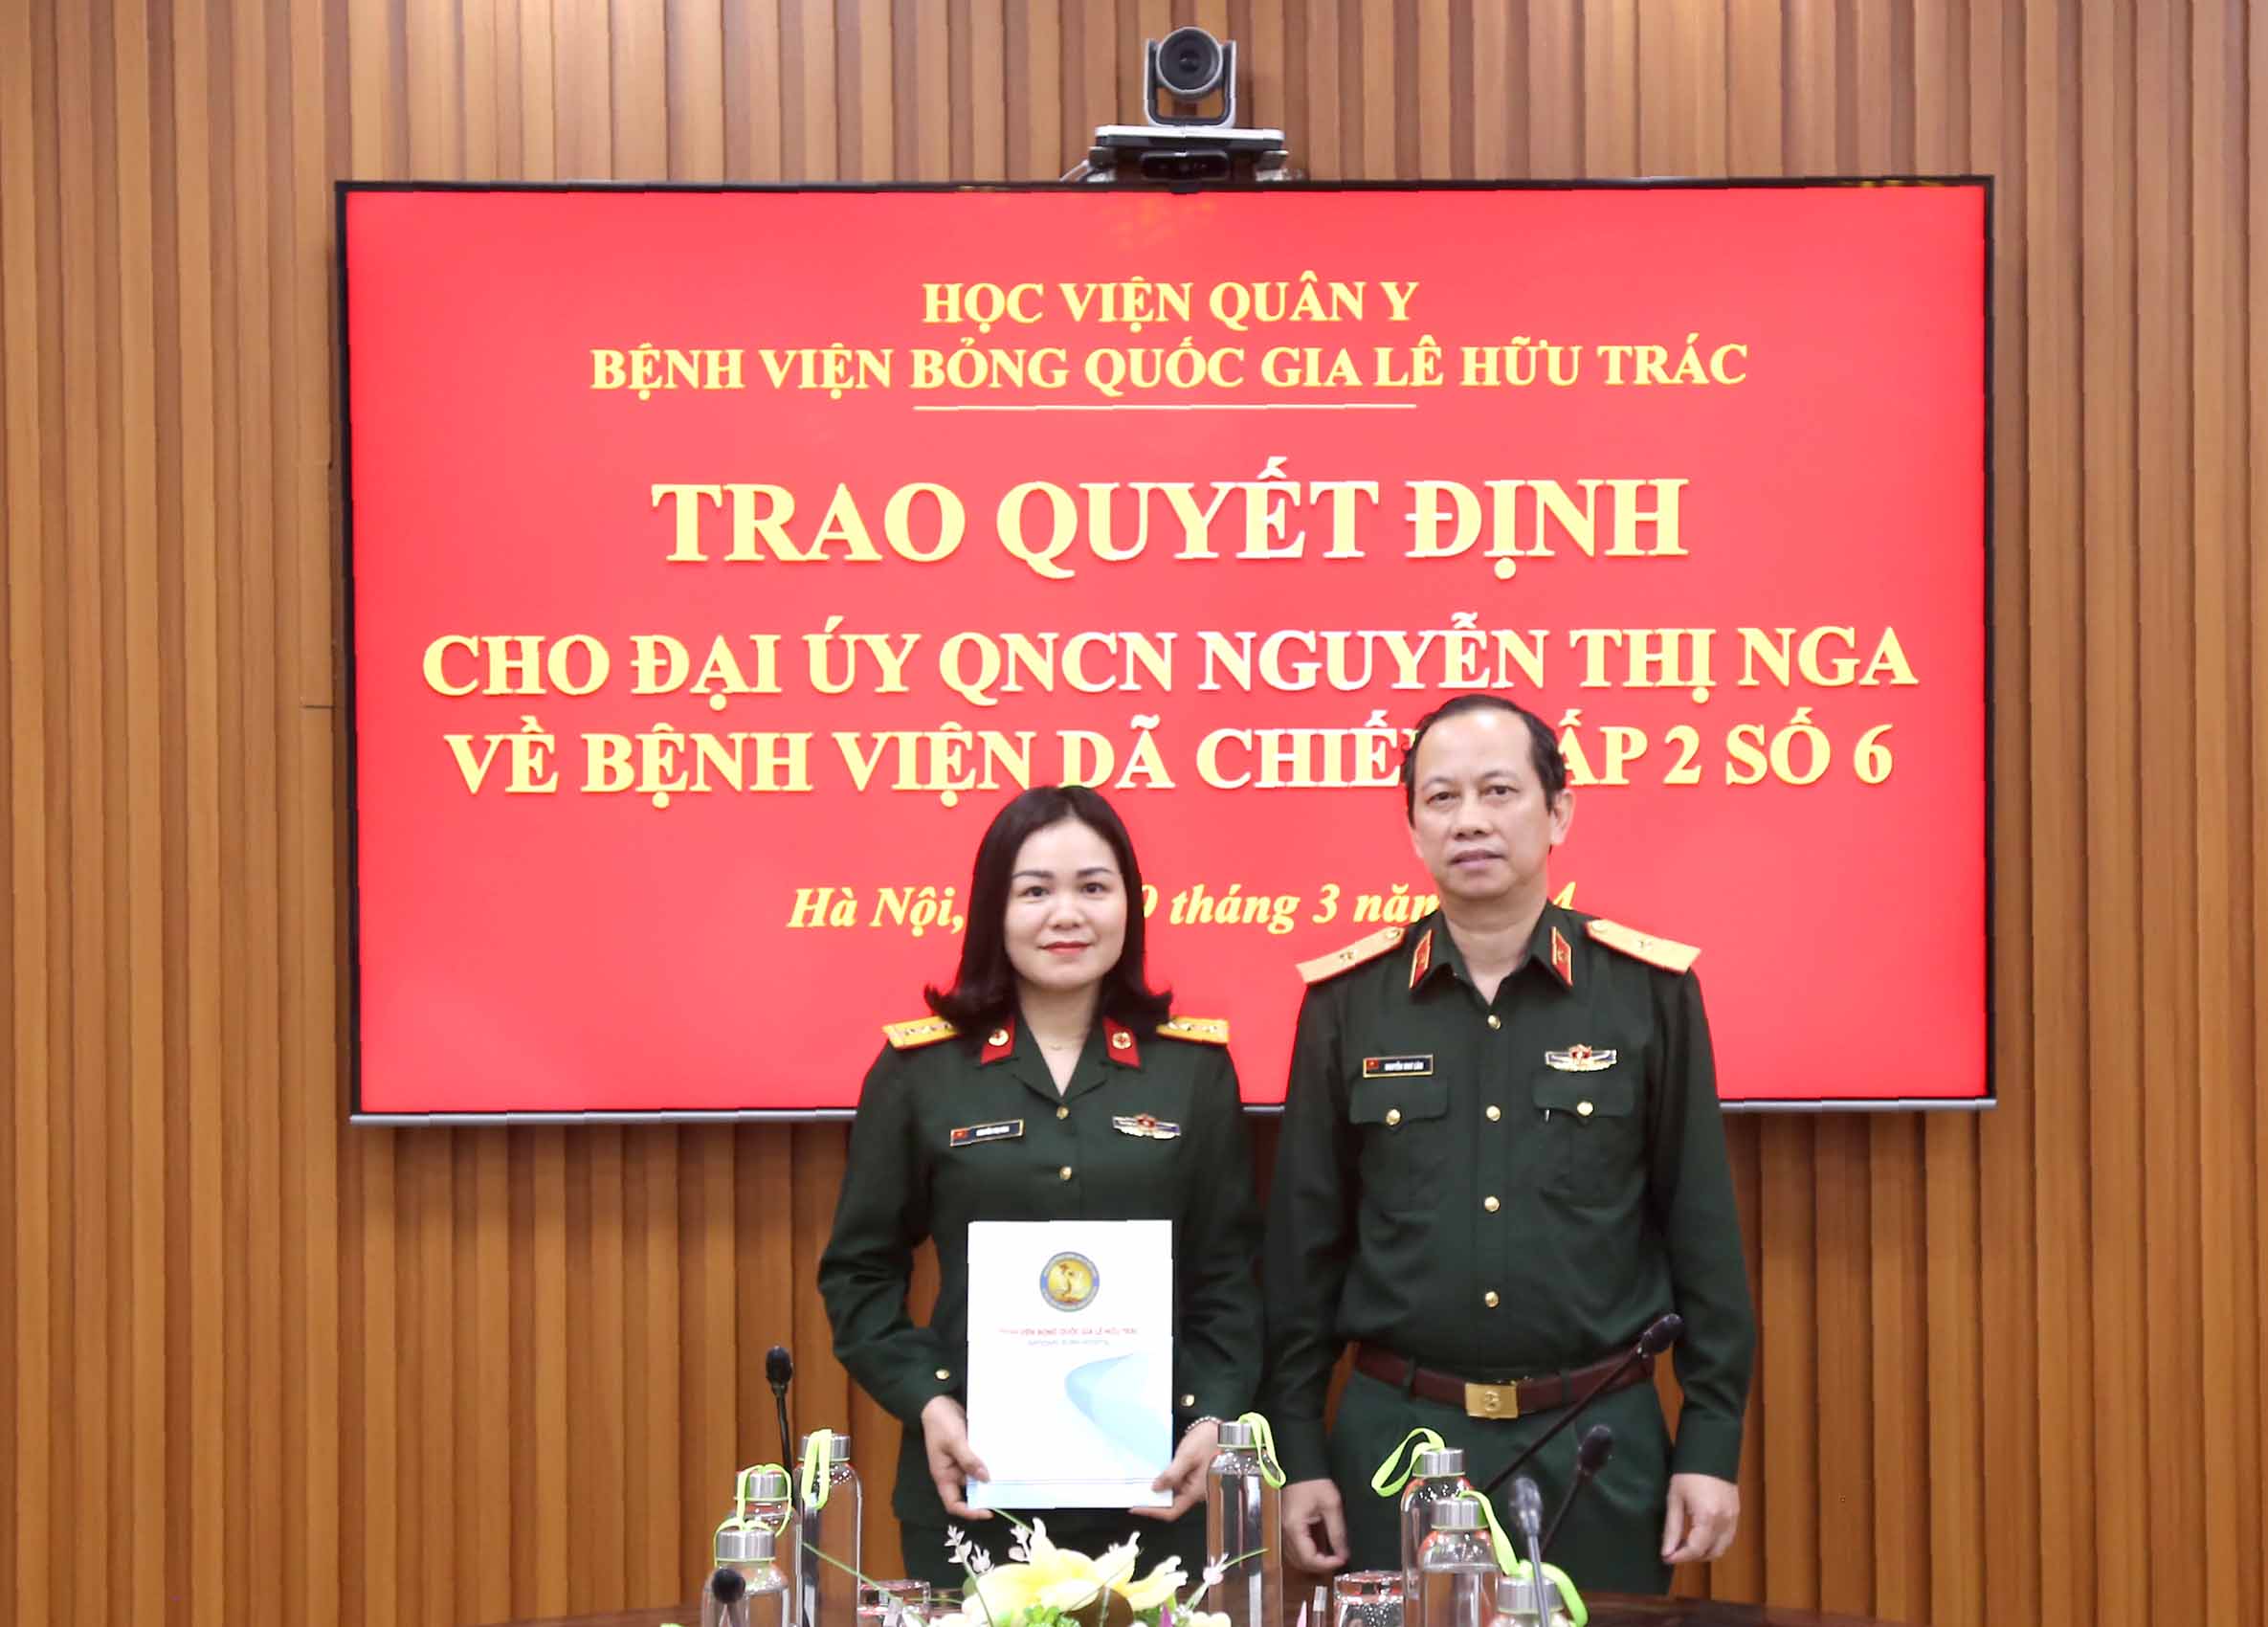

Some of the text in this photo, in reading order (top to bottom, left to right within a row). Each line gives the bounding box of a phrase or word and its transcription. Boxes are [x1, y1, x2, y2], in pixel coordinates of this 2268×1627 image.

[922, 270, 1419, 334] HỌC VIỆN QUÂN Y
[589, 332, 1748, 401] BỆNH VIỆN BỎNG QUỐC GIA LÊ HỮU TRÁC
[651, 456, 1690, 580] TRAO QUYẾT ĐỊNH
[422, 611, 1920, 711] CHO ĐẠI ÚY QNCN NGUYỄN THỊ NGA
[443, 706, 1893, 809] VỀ BỆNH VIỆN DÃ CHIẾ ẤP 2 SỐ 6
[786, 886, 858, 928] Hà
[868, 885, 965, 938] Nội,
[1168, 882, 1301, 935] tháng
[1311, 882, 1341, 924] 3
